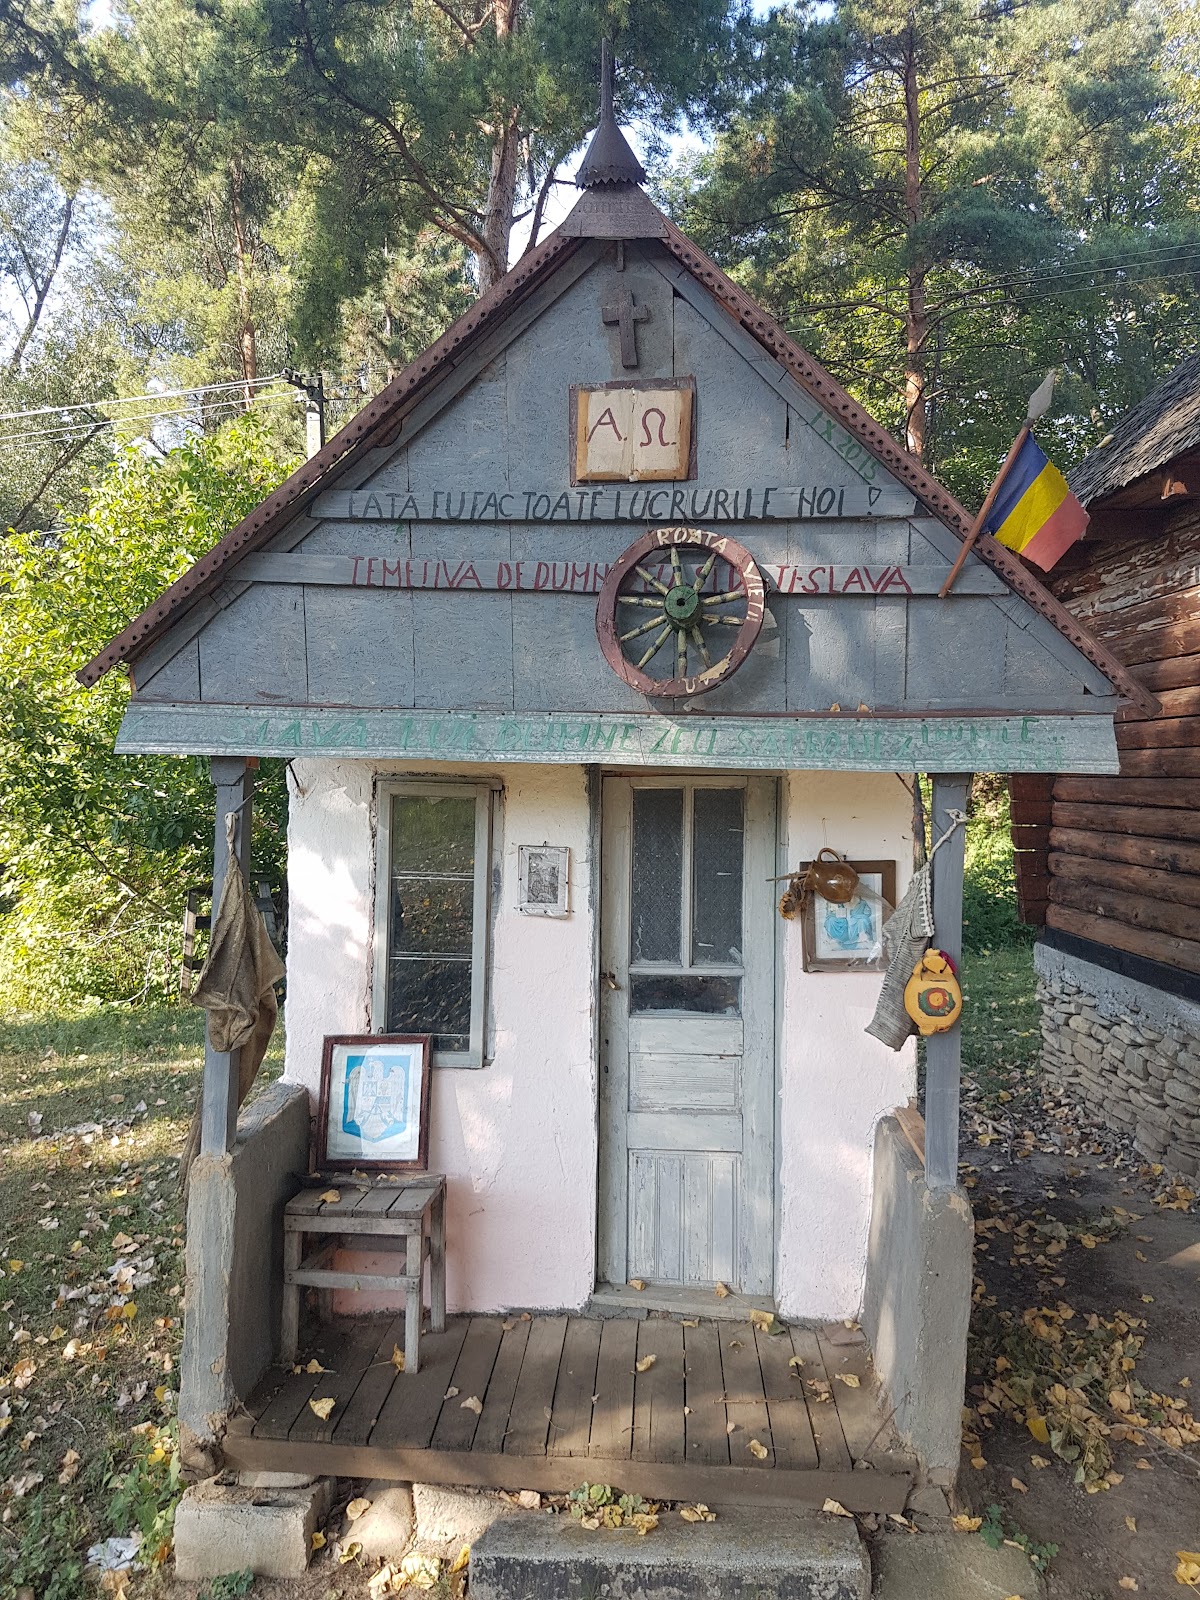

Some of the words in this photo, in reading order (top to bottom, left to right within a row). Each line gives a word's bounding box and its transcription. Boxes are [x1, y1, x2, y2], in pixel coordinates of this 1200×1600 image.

[522, 490, 604, 521] TOATE
[613, 487, 779, 521] LUCRURILE
[797, 484, 845, 518] NOI
